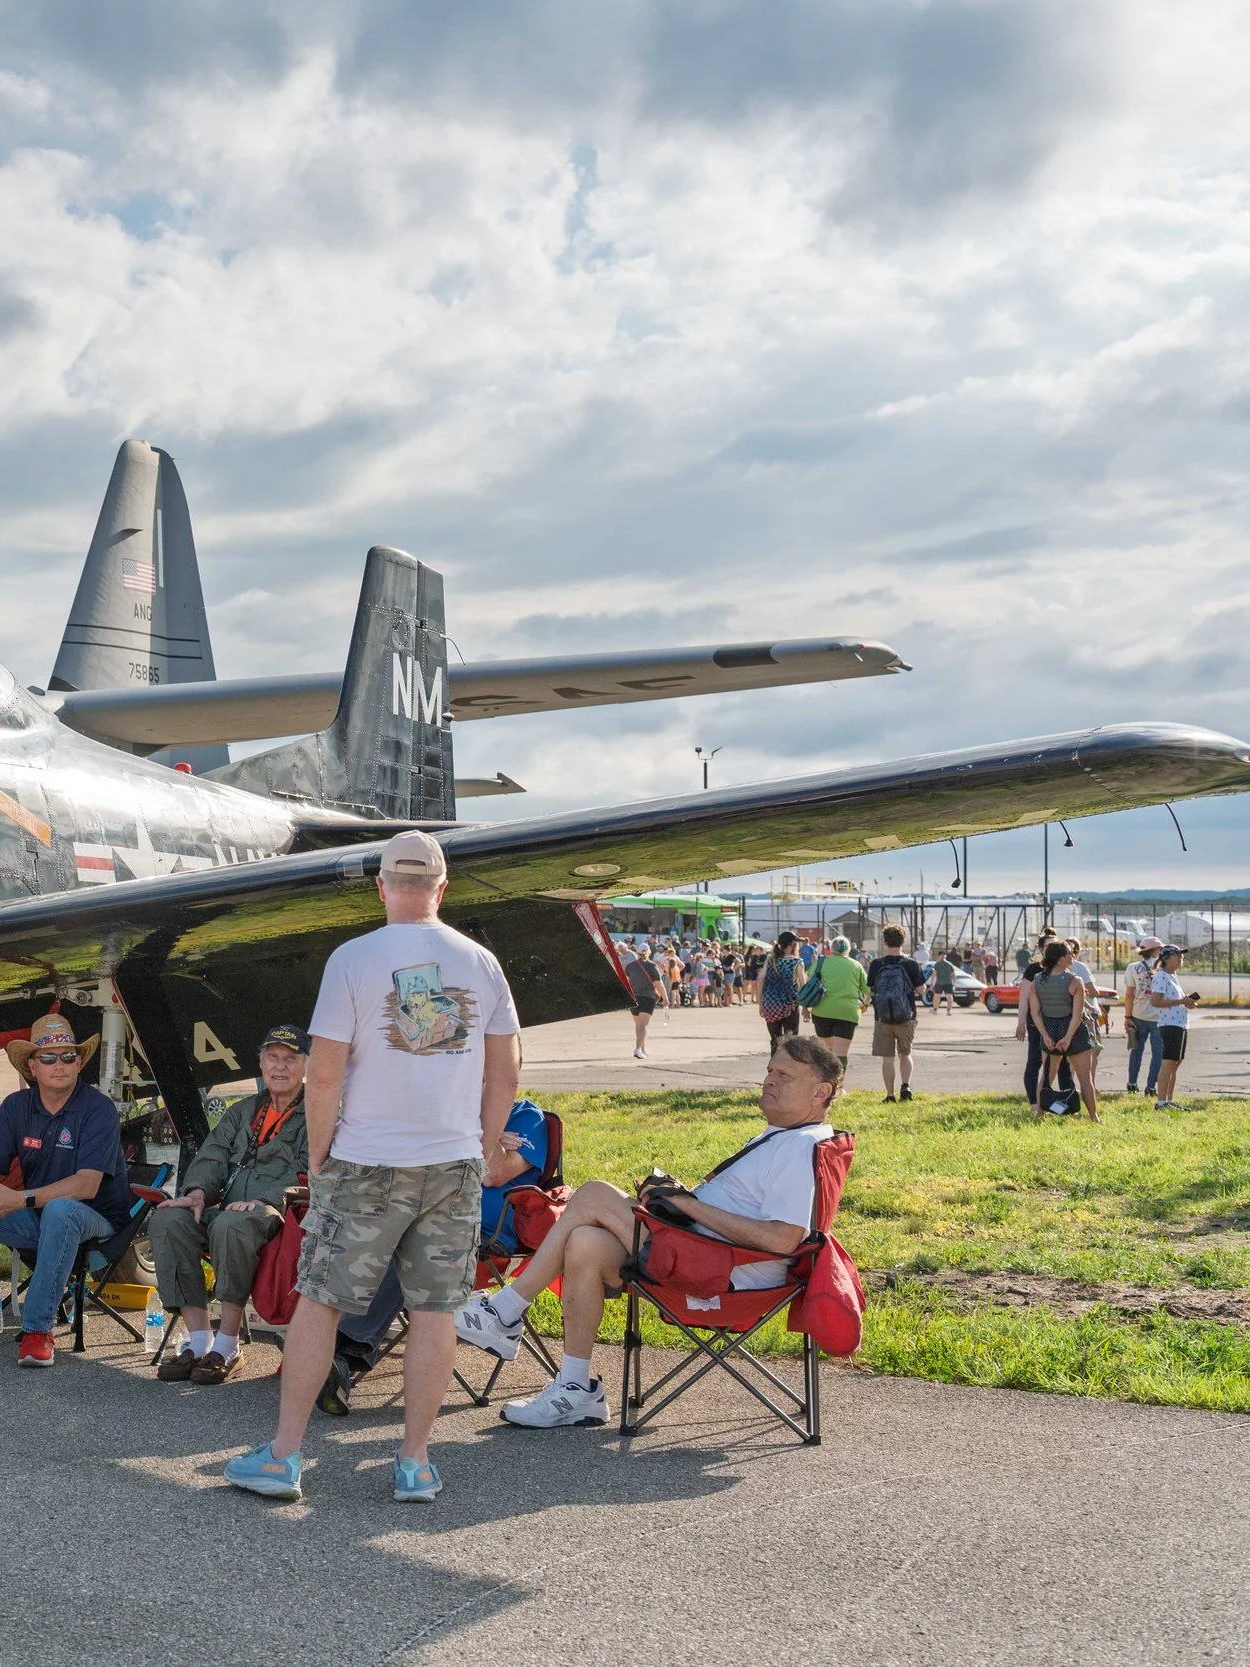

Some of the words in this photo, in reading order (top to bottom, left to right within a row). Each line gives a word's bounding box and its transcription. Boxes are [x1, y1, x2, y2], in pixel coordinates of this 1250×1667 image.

[133, 603, 152, 621] ANG
[128, 662, 160, 684] 75865
[392, 652, 443, 727] NM
[193, 1021, 242, 1071] 4
[463, 1311, 483, 1331] N
[550, 1396, 574, 1415] N
